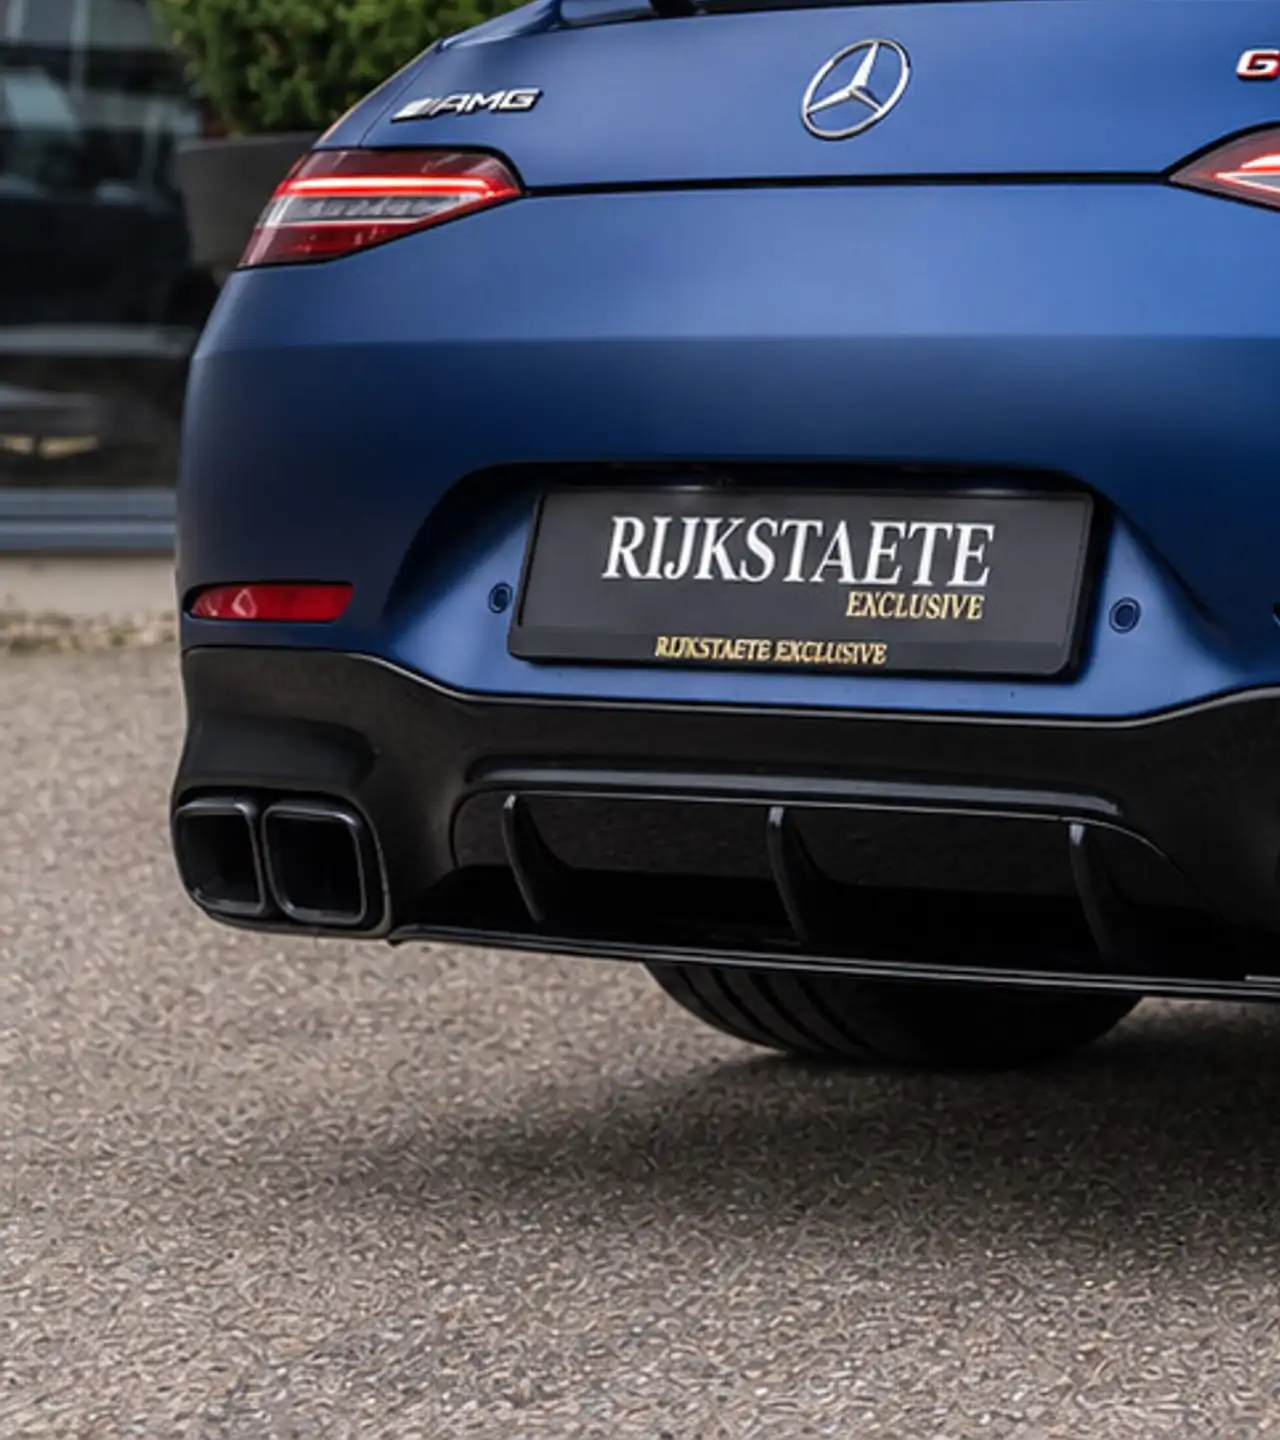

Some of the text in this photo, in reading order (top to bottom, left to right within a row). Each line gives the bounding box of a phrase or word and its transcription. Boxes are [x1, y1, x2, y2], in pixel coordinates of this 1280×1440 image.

[602, 515, 995, 587] RIJKSTAETE
[845, 592, 986, 620] EXCLUSIVE
[655, 636, 888, 665] RIJKSTAETE EXCLUSIVE
